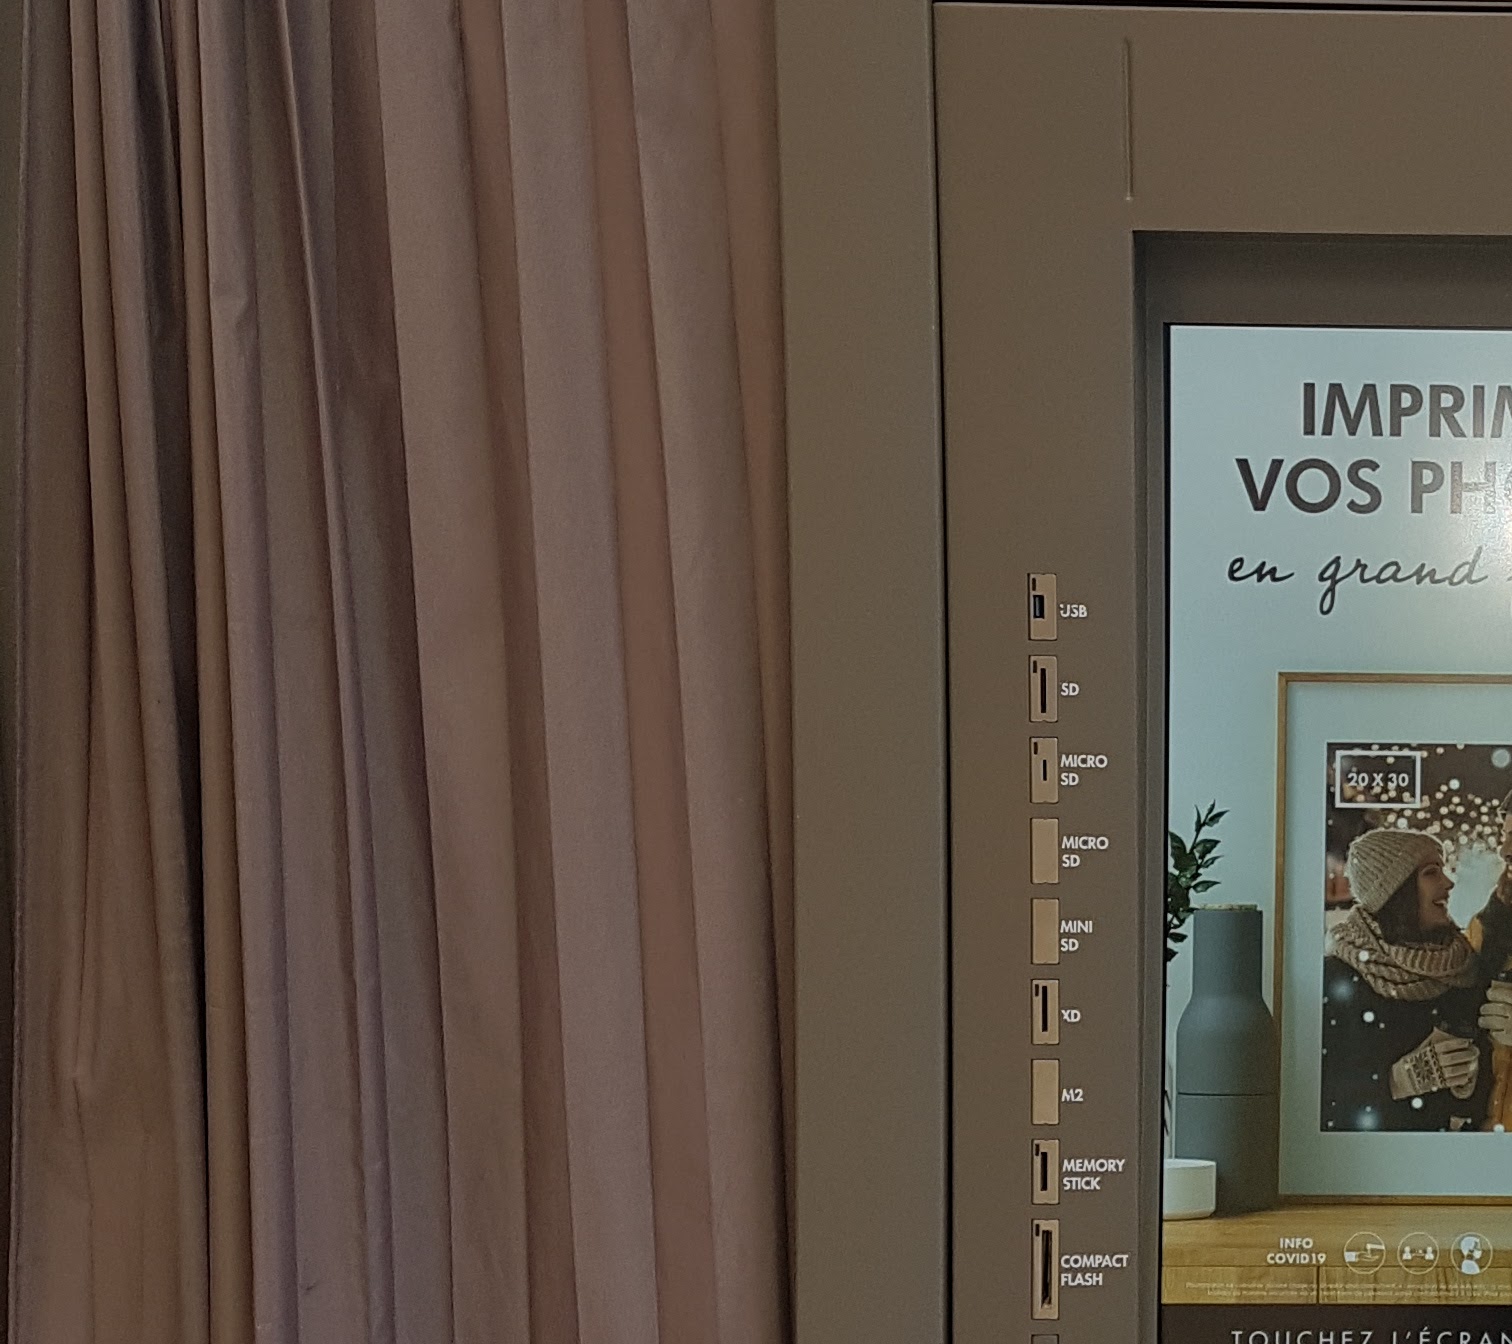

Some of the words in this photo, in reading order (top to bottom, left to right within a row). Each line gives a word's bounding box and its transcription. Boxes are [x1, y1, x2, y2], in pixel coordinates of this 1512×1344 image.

[1235, 458, 1382, 514] VOS
[1227, 555, 1295, 584] en
[1318, 547, 1488, 616] grand
[1060, 604, 1087, 618] USB
[1061, 683, 1079, 696] SD
[1060, 755, 1107, 768] MICRO
[1060, 773, 1079, 786] SD
[1347, 773, 1369, 787] 20
[1372, 773, 1384, 787] X
[1387, 773, 1409, 787] 30
[1062, 837, 1108, 849] MICRO
[1062, 855, 1080, 867] SD
[1060, 920, 1092, 933] MINI
[1061, 939, 1079, 951] SD
[1061, 1010, 1080, 1022] XD
[1062, 1089, 1083, 1102] M2
[1063, 1159, 1125, 1173] MEMORY
[1063, 1178, 1100, 1190] STICK
[1279, 1238, 1313, 1250] INFO
[1061, 1255, 1128, 1268] COMPACT
[1266, 1252, 1327, 1265] COVID19
[1061, 1273, 1102, 1286] FLASH
